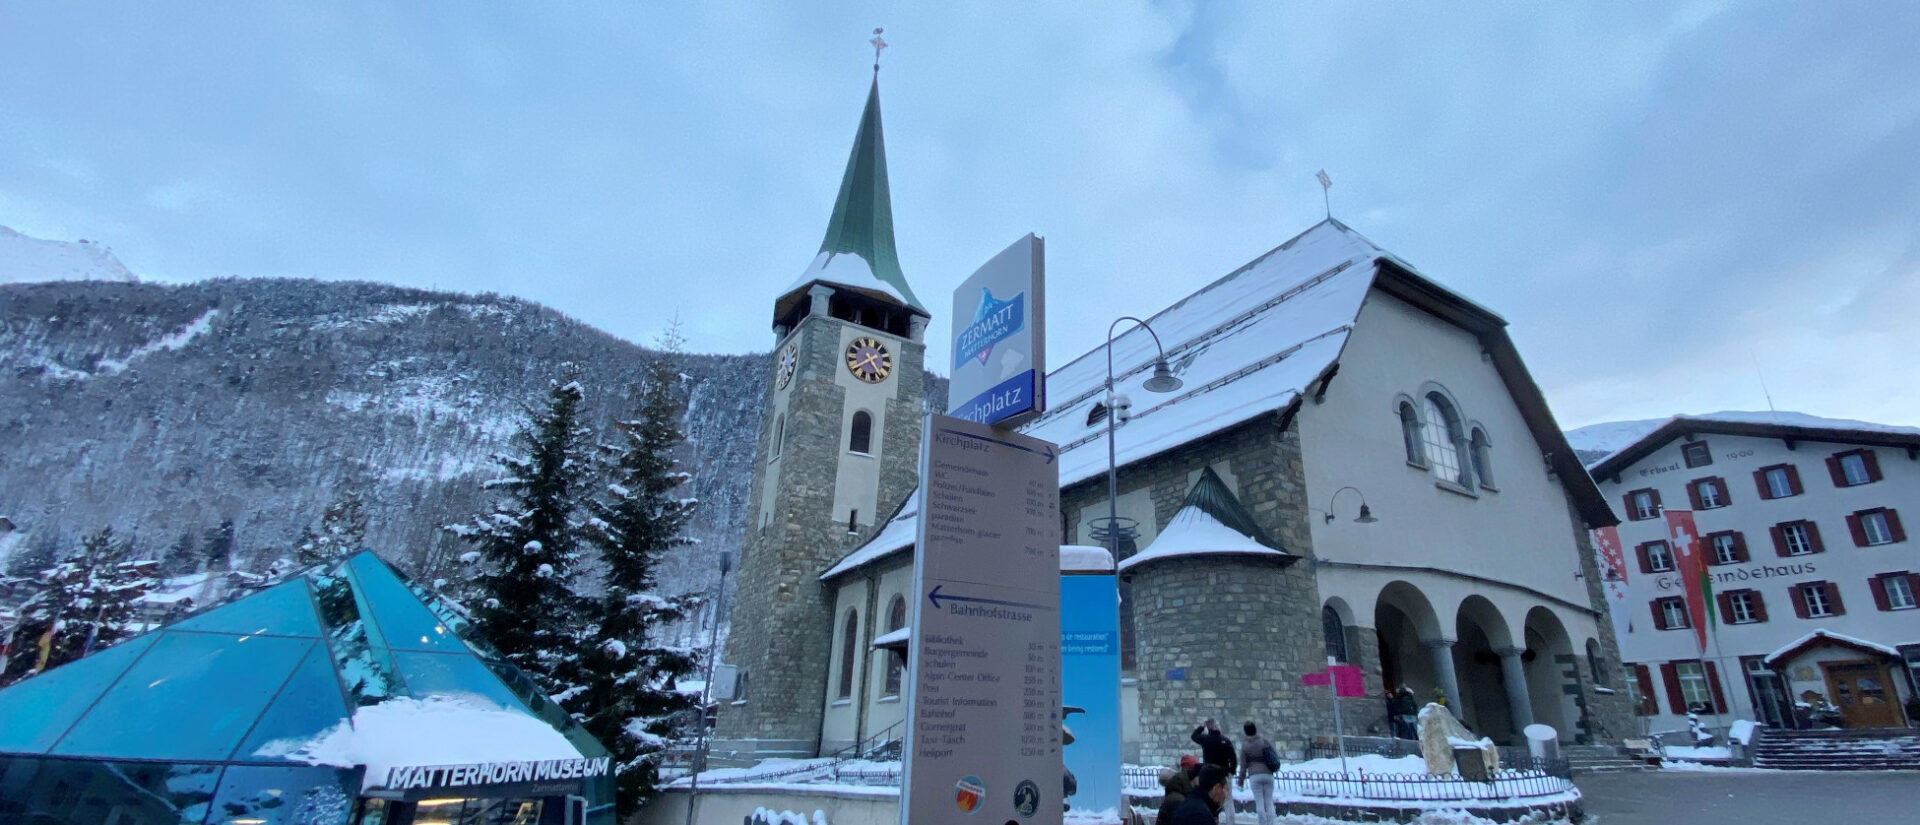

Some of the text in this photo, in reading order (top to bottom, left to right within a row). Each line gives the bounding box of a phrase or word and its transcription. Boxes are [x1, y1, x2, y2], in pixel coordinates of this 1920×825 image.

[962, 304, 1014, 350] ZERMATT
[964, 325, 1008, 358] MATTERHORN
[935, 431, 990, 452] Kirchplatz
[950, 603, 1033, 622] Bahnhofstrasse
[921, 709, 956, 719] Bahnhof
[389, 756, 611, 790] MATTERHORN MUSEUM
